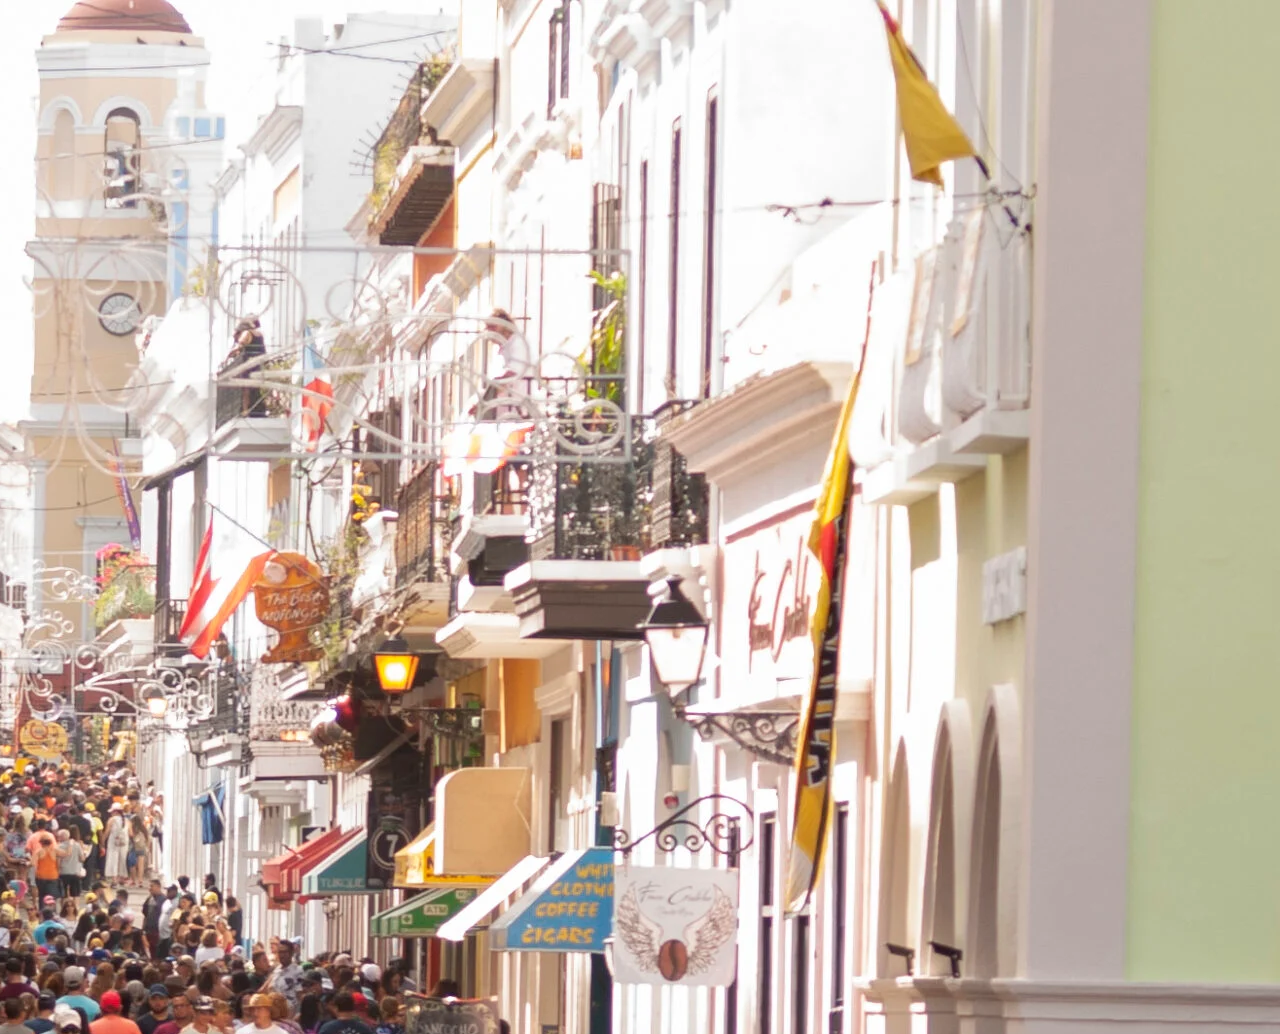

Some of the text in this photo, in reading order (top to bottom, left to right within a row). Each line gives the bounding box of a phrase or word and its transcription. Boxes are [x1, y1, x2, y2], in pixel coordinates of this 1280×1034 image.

[386, 834, 398, 858] 7
[426, 906, 447, 914] ATM
[535, 902, 599, 917] COFFEE
[522, 927, 594, 944] CIGARS
